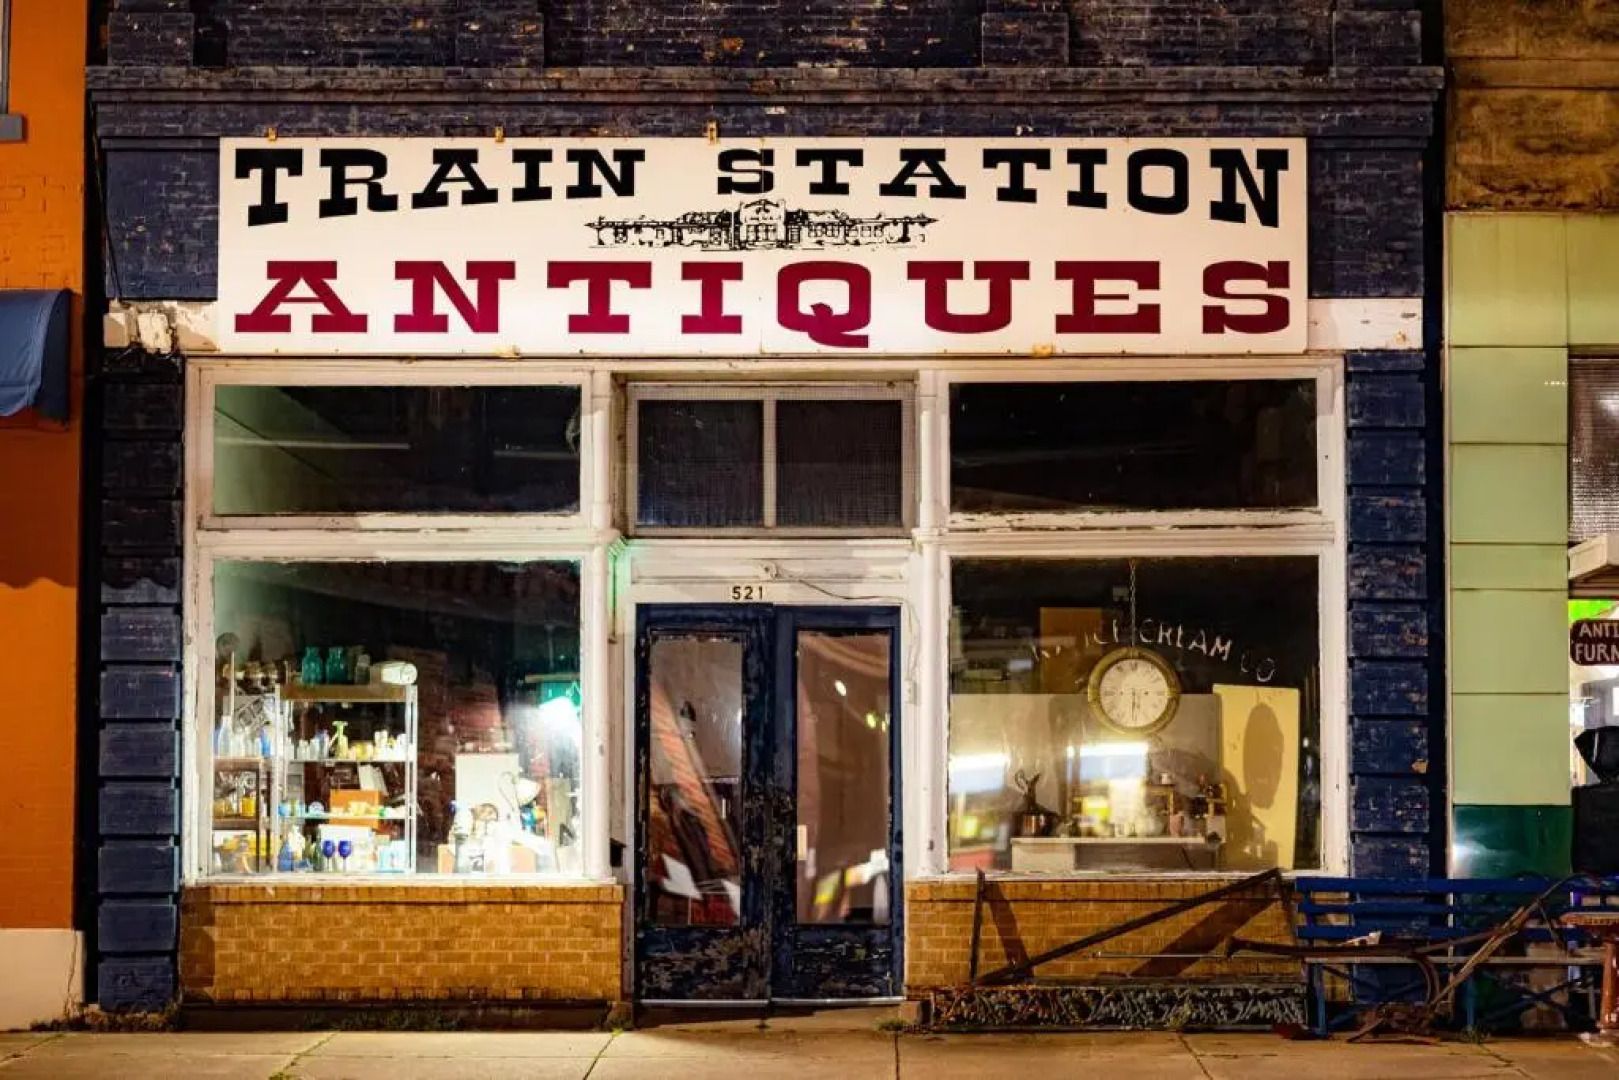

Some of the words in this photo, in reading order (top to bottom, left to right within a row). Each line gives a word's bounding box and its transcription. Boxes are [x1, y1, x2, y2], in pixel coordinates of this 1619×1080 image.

[235, 148, 646, 226] TRAIN
[716, 148, 1290, 229] STATION
[235, 260, 1291, 348] ANTIQUES
[732, 585, 763, 600] 521
